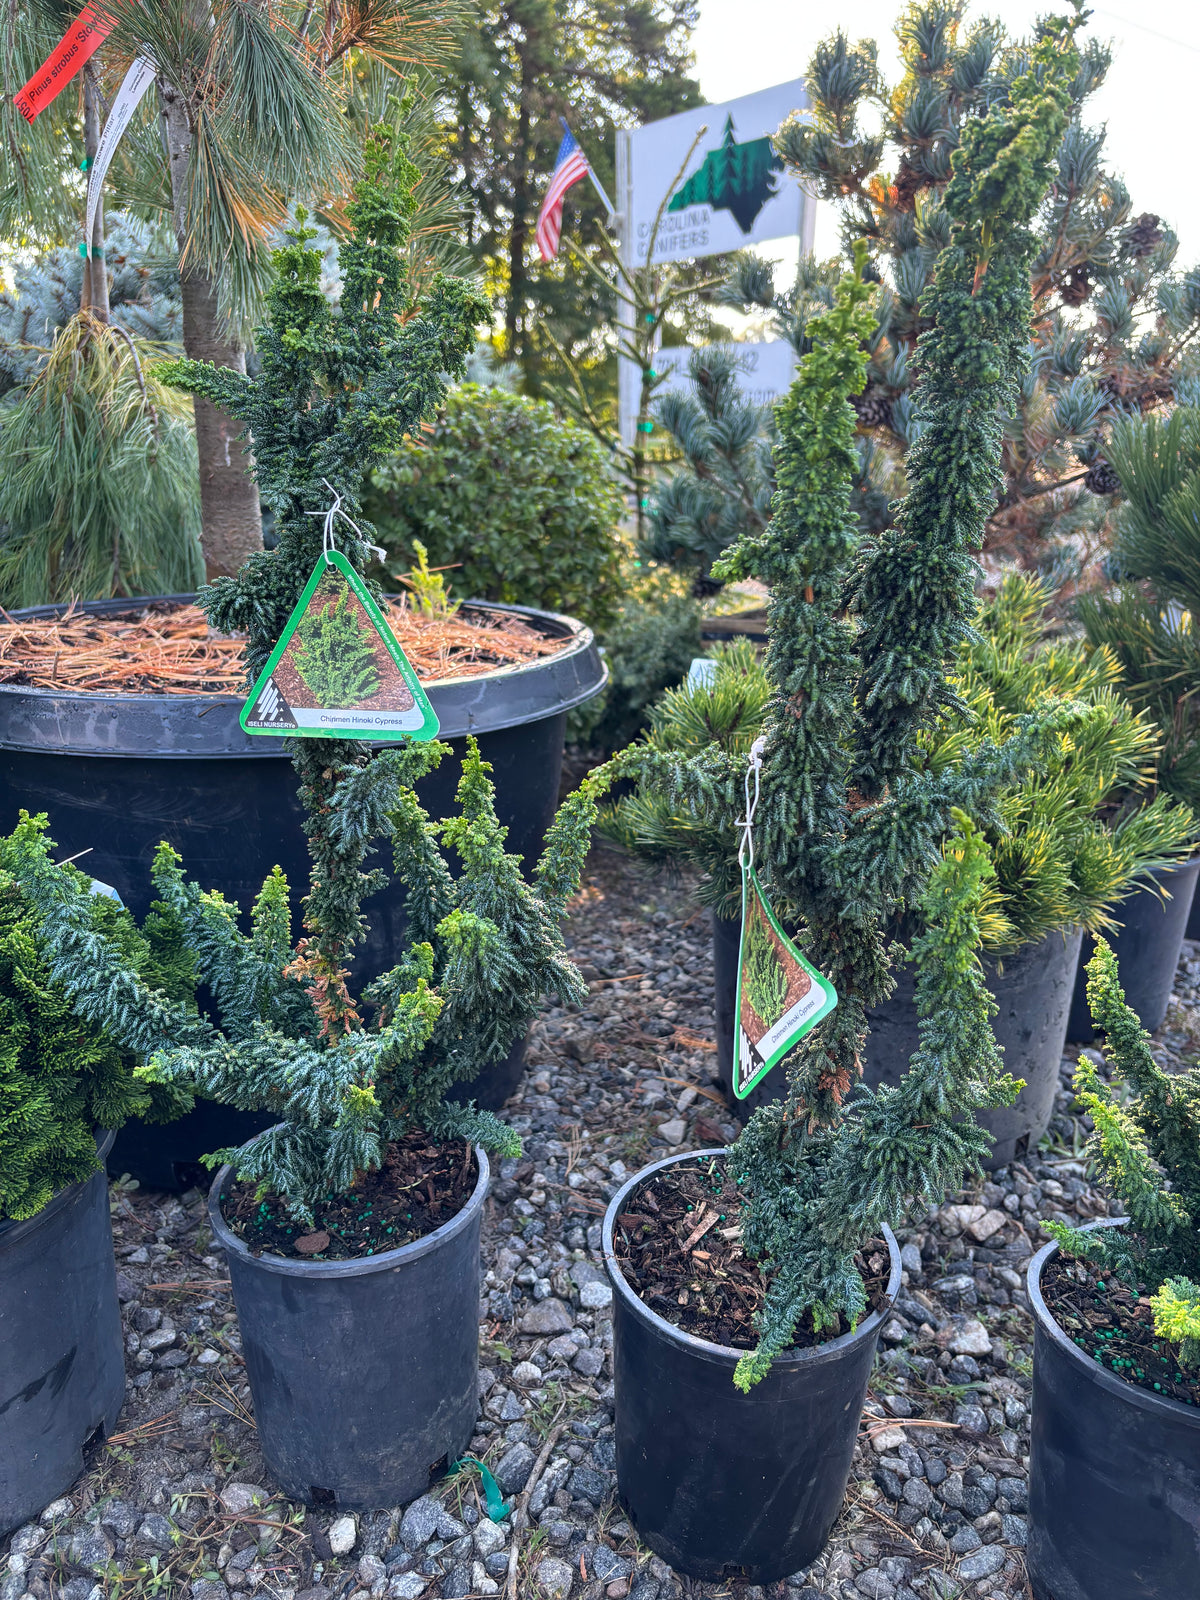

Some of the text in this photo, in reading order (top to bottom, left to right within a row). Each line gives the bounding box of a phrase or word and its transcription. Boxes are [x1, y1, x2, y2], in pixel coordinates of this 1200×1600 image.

[29, 76, 52, 101] Pinus
[51, 44, 79, 78] strobus
[16, 97, 34, 122] 7051
[637, 229, 709, 257] CNIFERS
[247, 720, 263, 728] ISELI
[351, 716, 374, 724] Hinoki
[374, 717, 403, 725] Cypress
